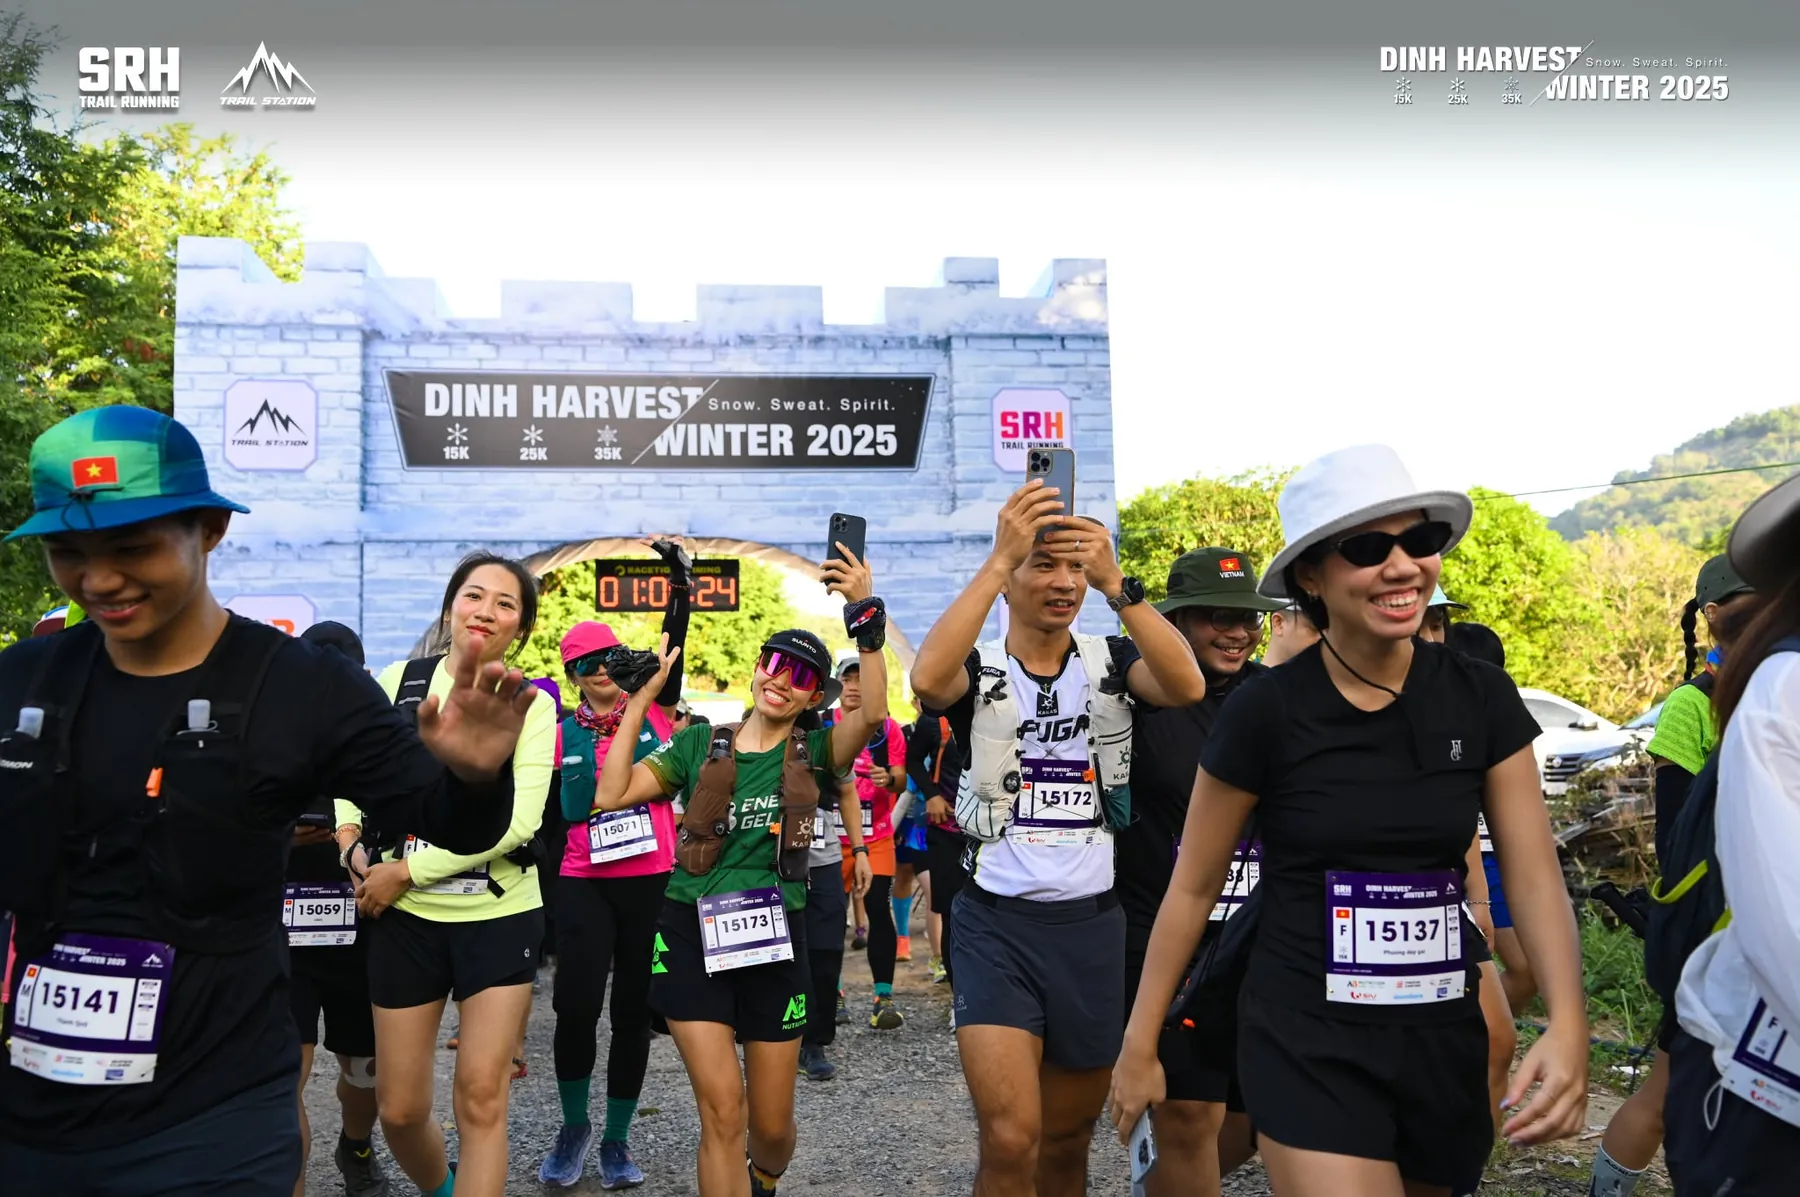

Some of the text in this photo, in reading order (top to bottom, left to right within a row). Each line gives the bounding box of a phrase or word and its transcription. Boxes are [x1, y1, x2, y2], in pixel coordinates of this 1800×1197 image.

[424, 383, 704, 419] DINH HARVEST
[708, 398, 896, 413] Snow. Sweat. Spirit.
[1001, 411, 1063, 439] SRH
[654, 423, 898, 456] WINTER 2025
[443, 446, 470, 460] 15K
[519, 447, 548, 461] 25K
[594, 447, 622, 461] 35K
[627, 566, 722, 574] RACETIG IMING
[600, 576, 735, 607] 01:0:24
[791, 637, 817, 654] SUUNTO
[982, 667, 1001, 677] FUGA
[1020, 714, 1089, 743] FUGA
[741, 794, 779, 812] ENE
[1040, 790, 1092, 805] 15172
[603, 820, 637, 836] 15071
[741, 812, 774, 830] GEL
[299, 904, 341, 915] 15059
[722, 914, 768, 933] 15173
[1340, 925, 1347, 936] F
[1366, 919, 1439, 942] 15137
[21, 984, 30, 996] M
[42, 983, 119, 1014] 15141
[1768, 1016, 1779, 1028] F
